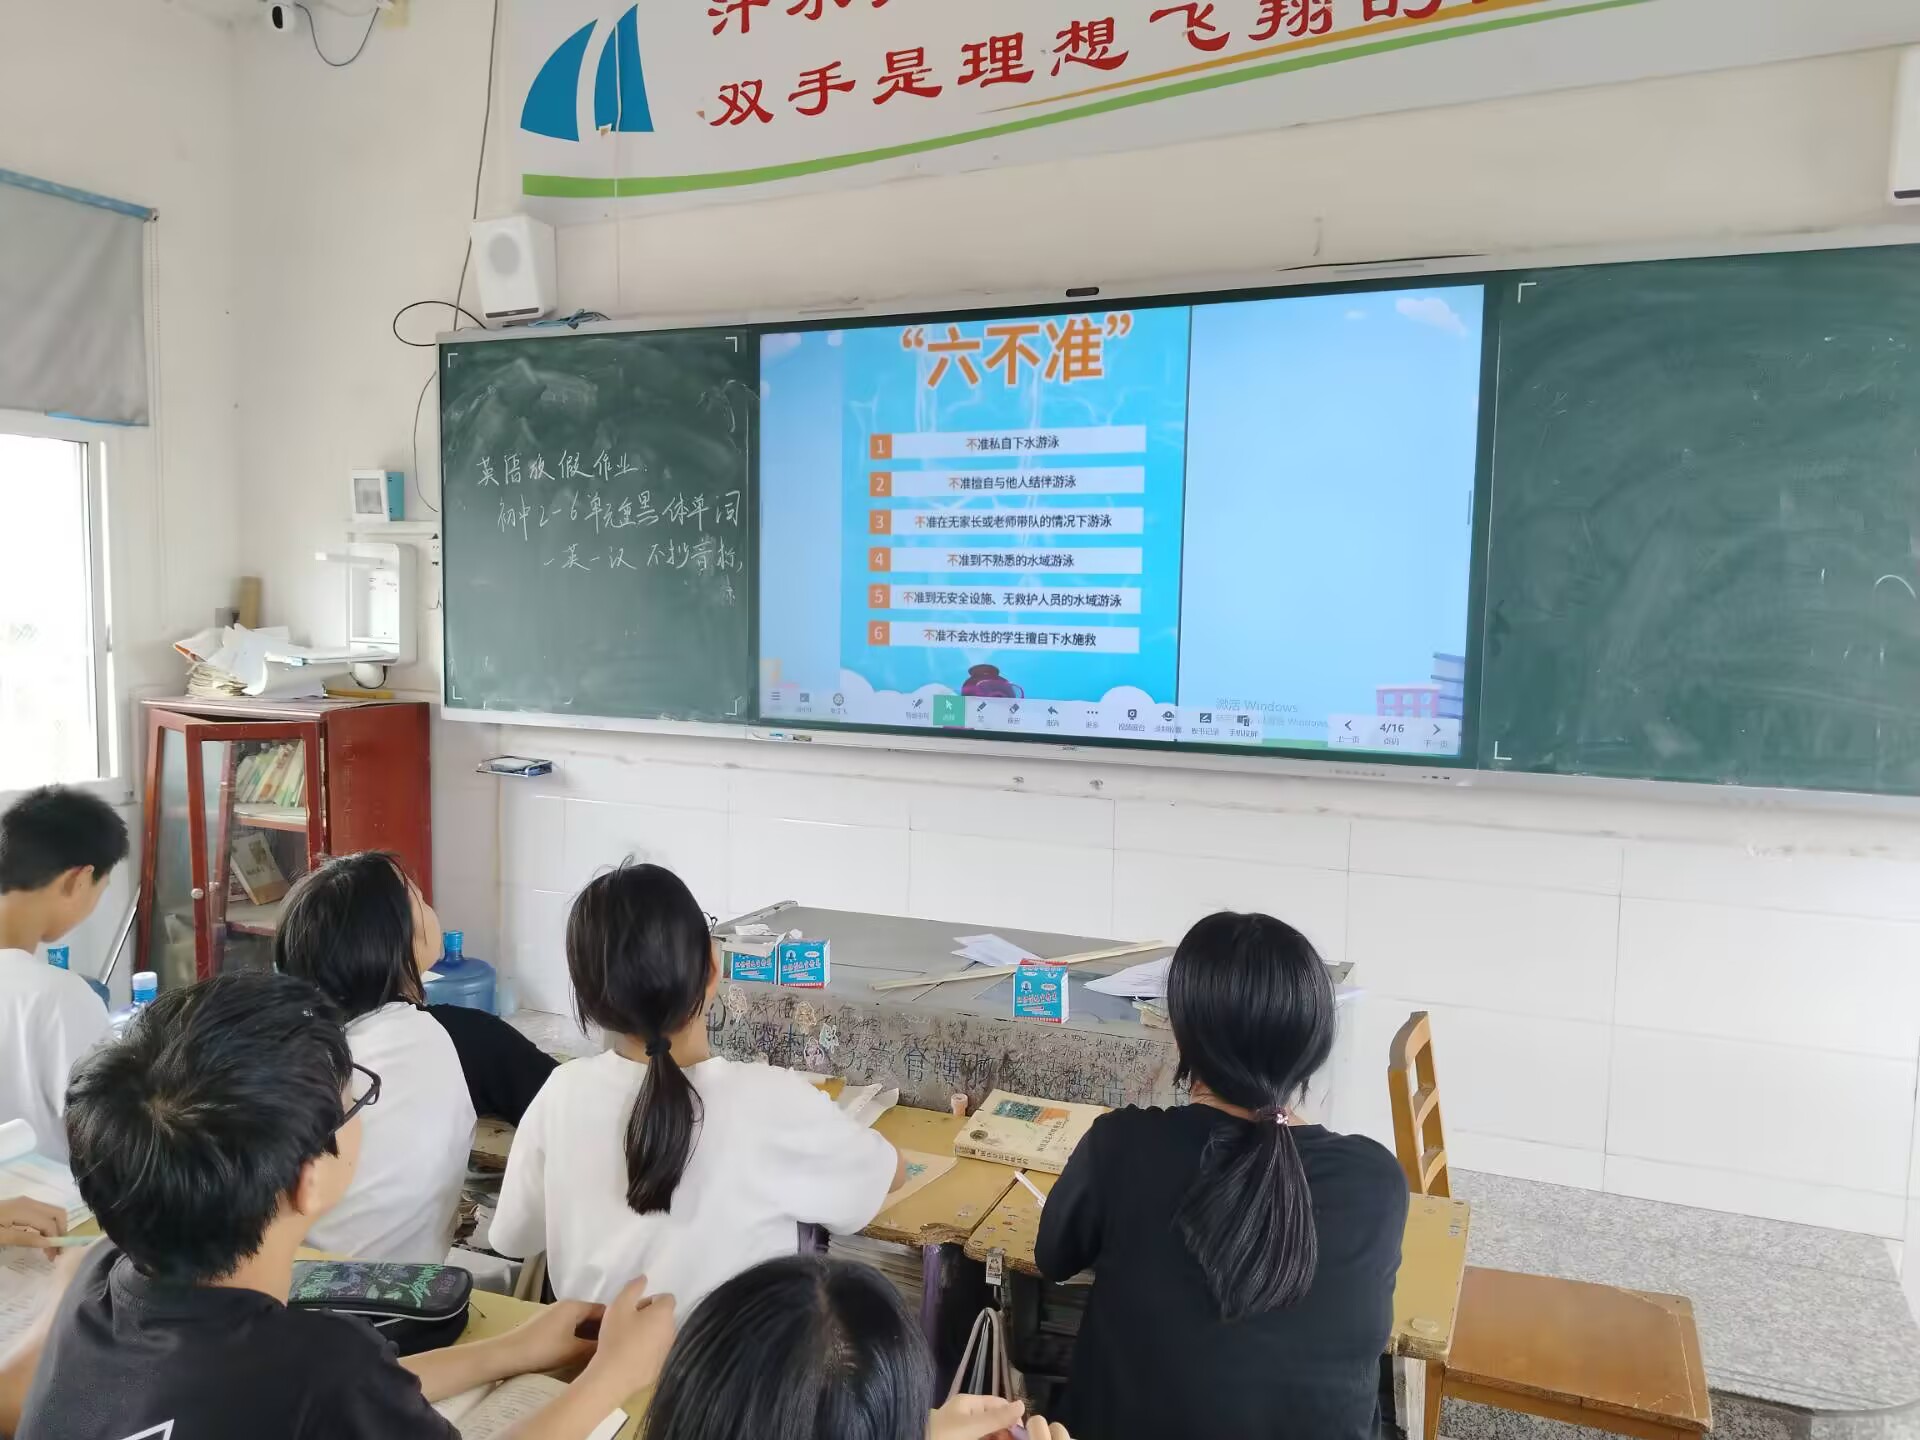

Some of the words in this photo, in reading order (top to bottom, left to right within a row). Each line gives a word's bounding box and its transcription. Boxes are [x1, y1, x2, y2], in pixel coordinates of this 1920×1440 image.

[902, 313, 1133, 388] “六不准”
[966, 435, 1060, 451] 不准私自下水游泳
[949, 475, 1077, 490] 不准擅自与他人结伴游泳
[914, 514, 1112, 529] 不准在无家长或老师带队的情况下游泳
[947, 553, 1075, 568] 不准到不熟悉的水域游泳
[903, 591, 1122, 608] 不准到无安全设施、无救护人员的水域游泳
[923, 628, 1097, 646] 不准不会水性的学生擅自下水施救
[1244, 699, 1299, 714] Windows
[1380, 723, 1405, 734] 4/16
